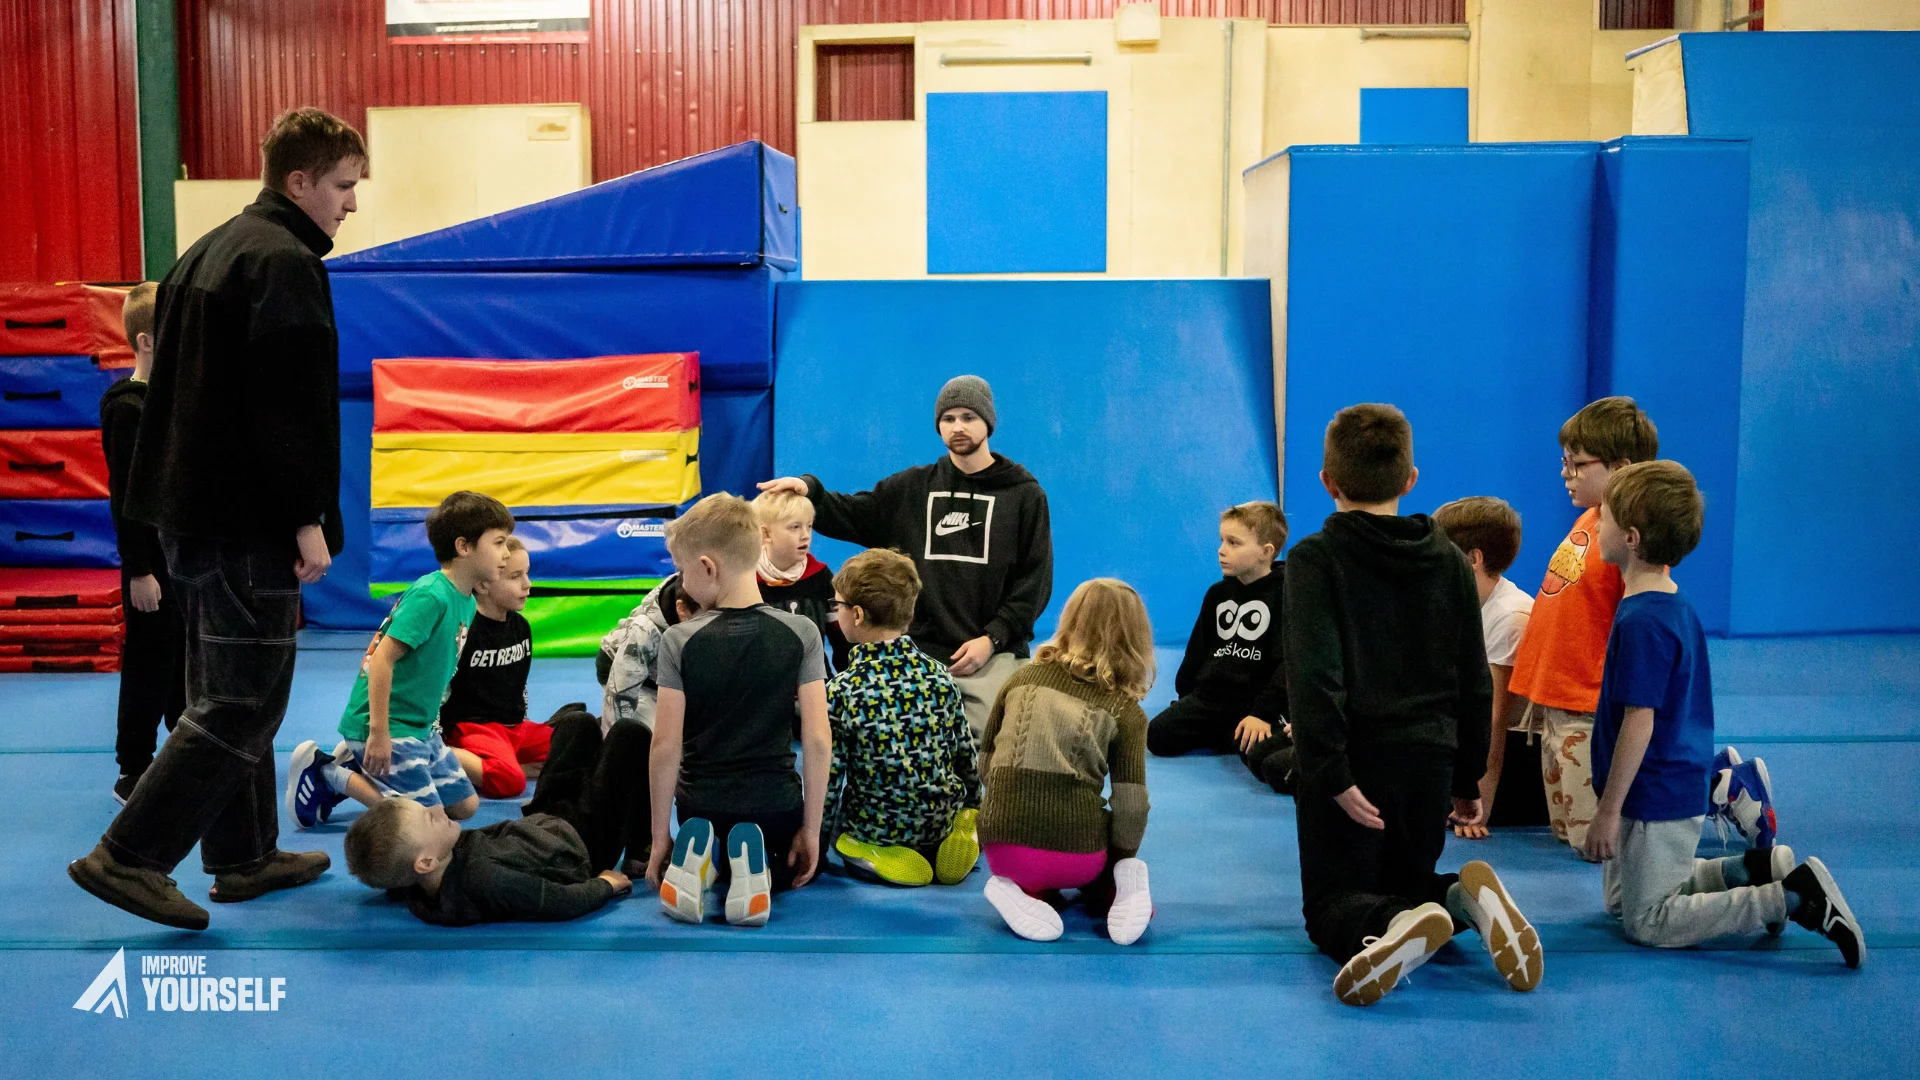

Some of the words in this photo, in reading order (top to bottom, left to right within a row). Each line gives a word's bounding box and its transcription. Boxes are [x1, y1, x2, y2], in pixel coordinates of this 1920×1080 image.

[636, 375, 669, 383] MASTER
[941, 511, 970, 527] NIKE
[470, 649, 497, 667] GET
